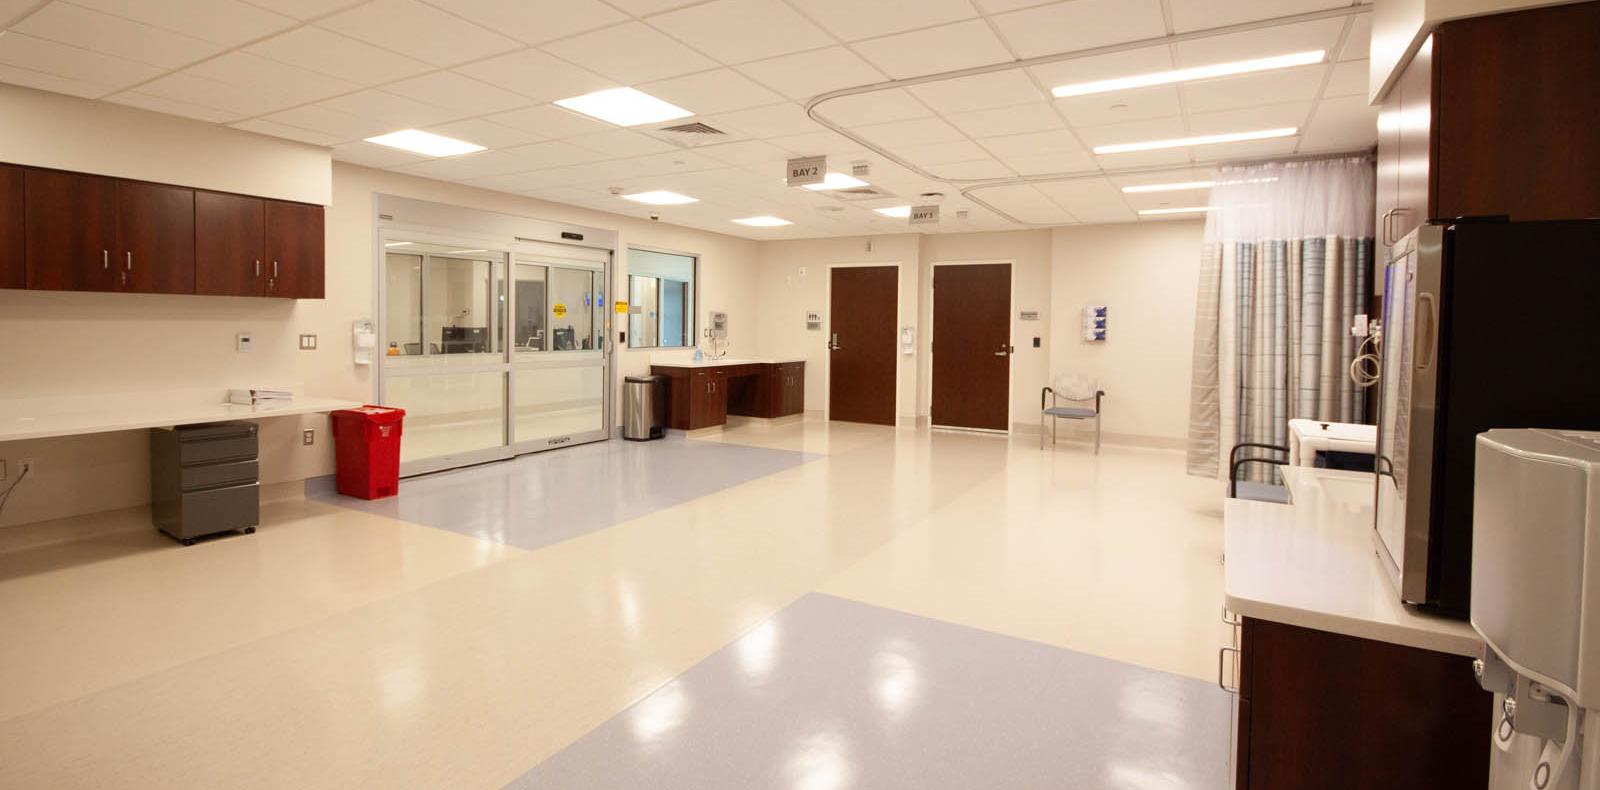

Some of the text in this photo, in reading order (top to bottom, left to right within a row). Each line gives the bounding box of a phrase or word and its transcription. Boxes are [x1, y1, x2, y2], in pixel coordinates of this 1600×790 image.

[792, 167, 818, 178] BAY 2
[913, 212, 928, 220] BAY
